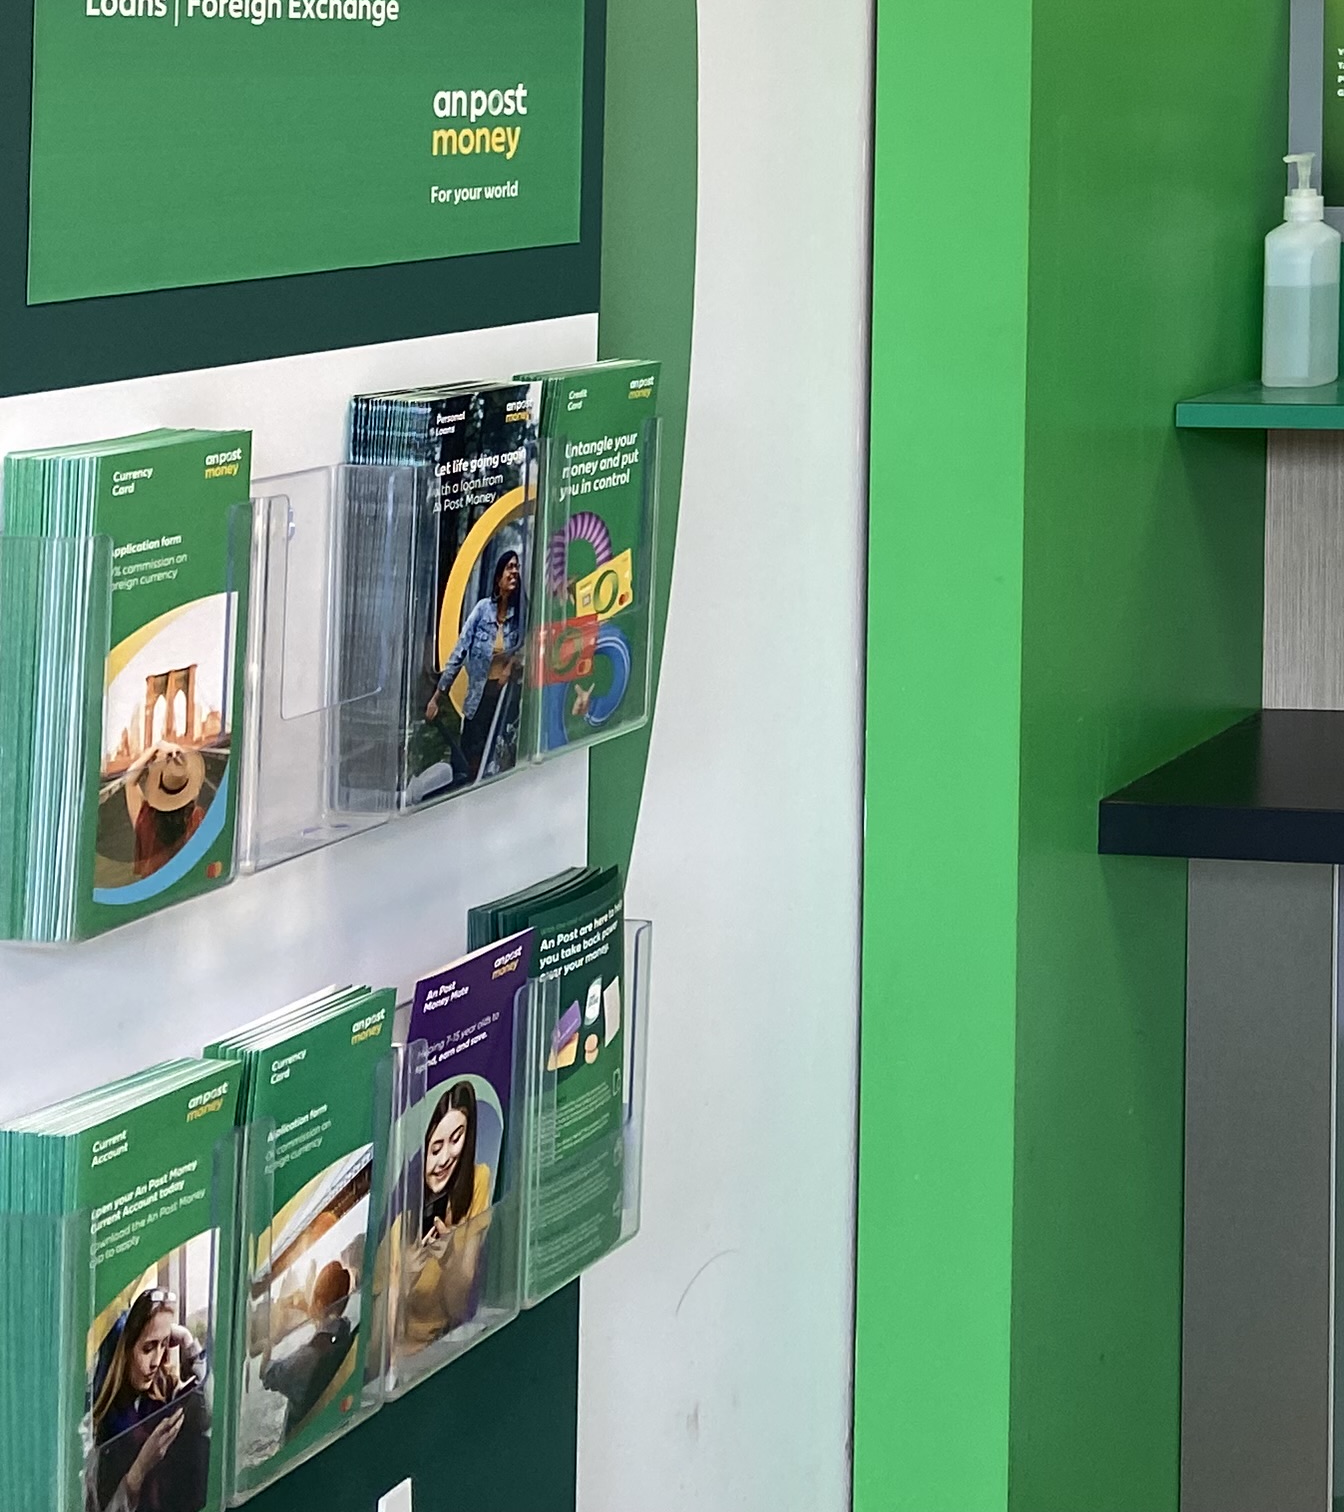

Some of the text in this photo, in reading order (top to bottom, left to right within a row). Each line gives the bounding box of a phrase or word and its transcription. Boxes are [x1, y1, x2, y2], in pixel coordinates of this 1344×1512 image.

[432, 126, 521, 159] money
[431, 180, 518, 205] For your world
[437, 411, 466, 425] Personal
[436, 425, 455, 437] Loans
[613, 432, 638, 450] your
[452, 452, 500, 474] life going
[600, 449, 640, 471] and put
[113, 468, 153, 482] Currency
[205, 464, 239, 479] money
[593, 469, 631, 491] control
[112, 483, 135, 496] Card
[161, 535, 182, 547] form
[122, 555, 175, 575] commission
[140, 569, 178, 585] currency
[556, 929, 578, 947] Post
[539, 945, 582, 970] you take
[92, 1129, 128, 1153] Current
[91, 1142, 129, 1168] Account
